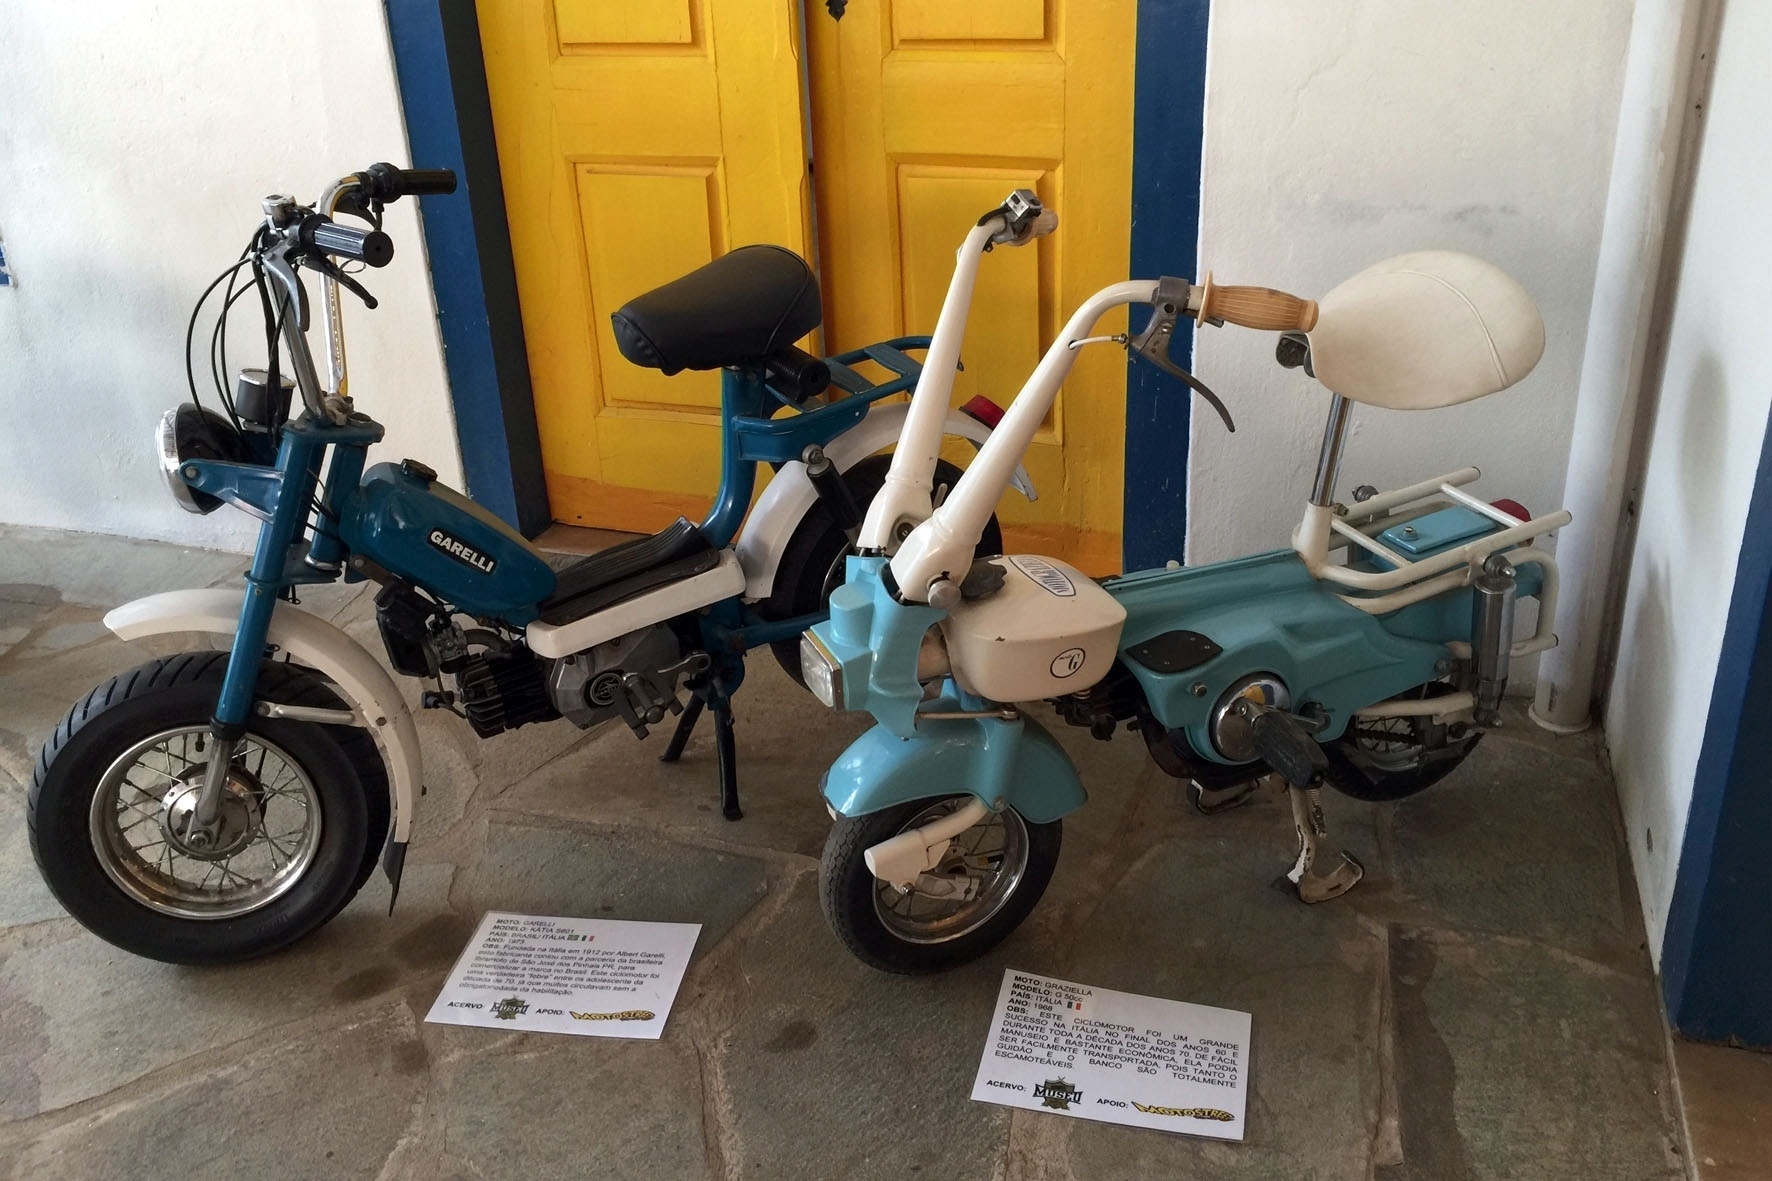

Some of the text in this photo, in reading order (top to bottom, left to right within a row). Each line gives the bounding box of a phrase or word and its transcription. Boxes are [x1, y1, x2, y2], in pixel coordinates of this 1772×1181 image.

[430, 531, 494, 572] GARELLI
[1009, 989, 1033, 1000] PAÍS:
[1011, 983, 1052, 996] MODELO:
[1013, 975, 1092, 996] MOTO: GRAZIELLA
[1007, 998, 1030, 1006] ANO:
[1002, 1020, 1045, 1033] DURANTE
[1048, 1028, 1074, 1037] TODA
[1085, 1033, 1123, 1046] DÉCADA
[1126, 1041, 1146, 1050] DOS
[1149, 1045, 1175, 1054] ANOS
[1004, 1013, 1048, 1025] SUCESSO
[1124, 1033, 1150, 1043] FINAL
[1156, 1038, 1176, 1047] DOS
[1182, 1043, 1209, 1053] ANOS
[1006, 1005, 1028, 1014] OBS:
[1039, 1011, 1062, 1020] ESTE
[1073, 1017, 1134, 1033] CICLOMOTOR
[1146, 1029, 1161, 1037] FOI
[1199, 1038, 1238, 1050] GRANDE
[998, 1035, 1017, 1043] SER
[1020, 1039, 1078, 1054] FACILMENTE
[1165, 1063, 1188, 1072] POIS
[1193, 1068, 1225, 1078] TANTO
[1000, 1027, 1048, 1041] MANUSEIO
[1064, 1038, 1113, 1052] BASTANTE
[1184, 1058, 1202, 1066] ELA
[1207, 1062, 1237, 1073] PODIA
[1088, 1058, 1122, 1069] BANCO
[1172, 1072, 1236, 1088] TOTALMENTE
[987, 1080, 1083, 1104] ACERVO: MUSEU
[1096, 1098, 1128, 1108] APOIO:
